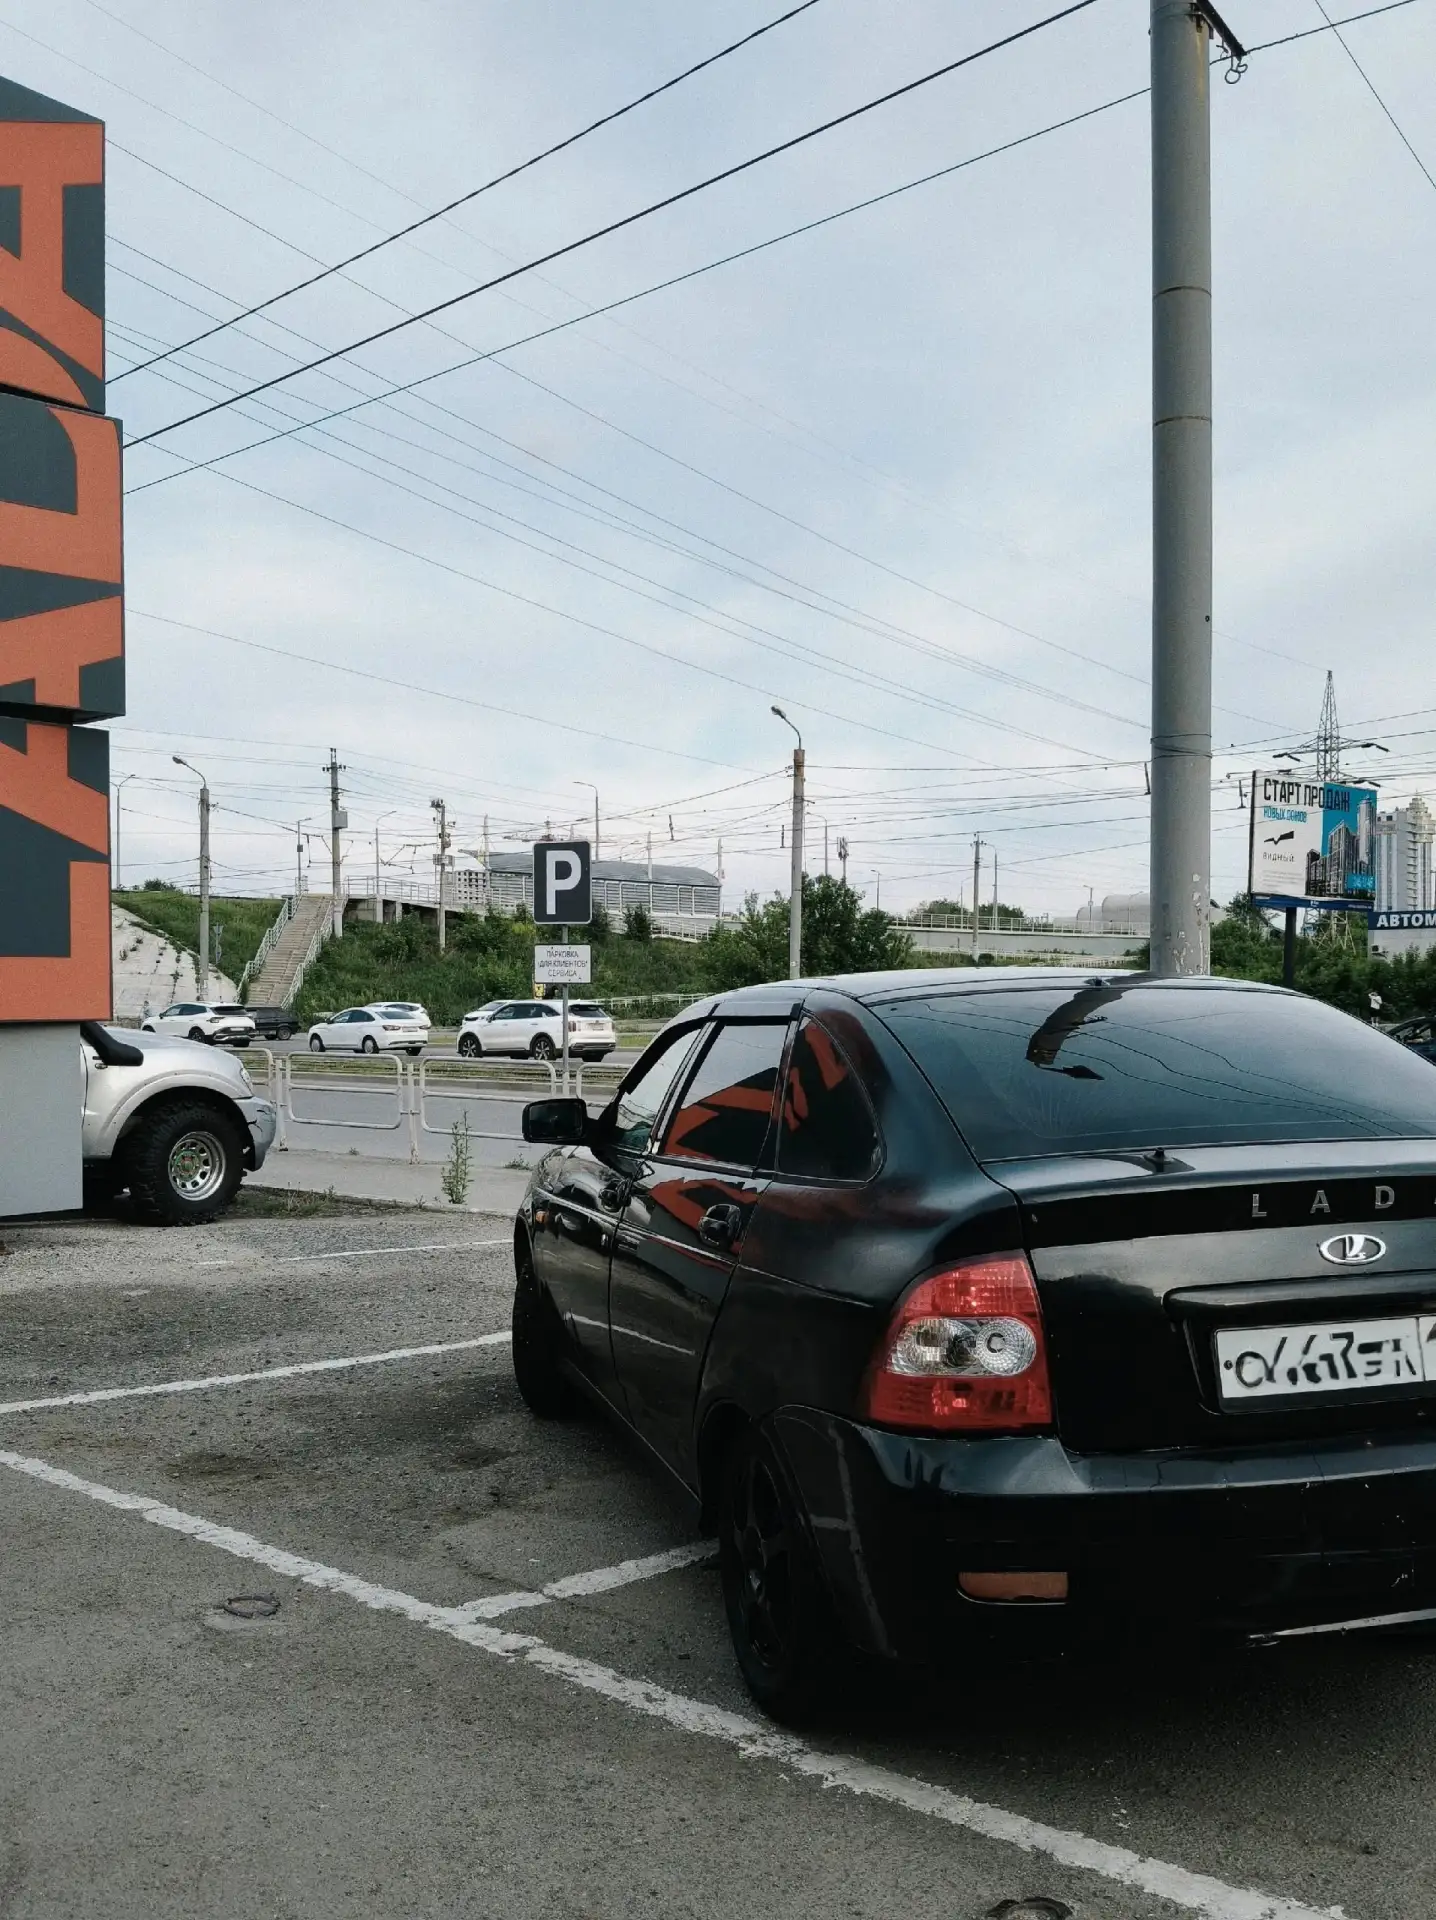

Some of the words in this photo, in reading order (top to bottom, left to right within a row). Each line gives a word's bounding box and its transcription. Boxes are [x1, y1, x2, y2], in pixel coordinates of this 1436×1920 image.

[1264, 778, 1301, 805] СТАРТ
[1303, 784, 1350, 813] ПРОДАЖ
[546, 950, 579, 958] ПАРКОВКА
[1251, 1185, 1436, 1218] LAD
